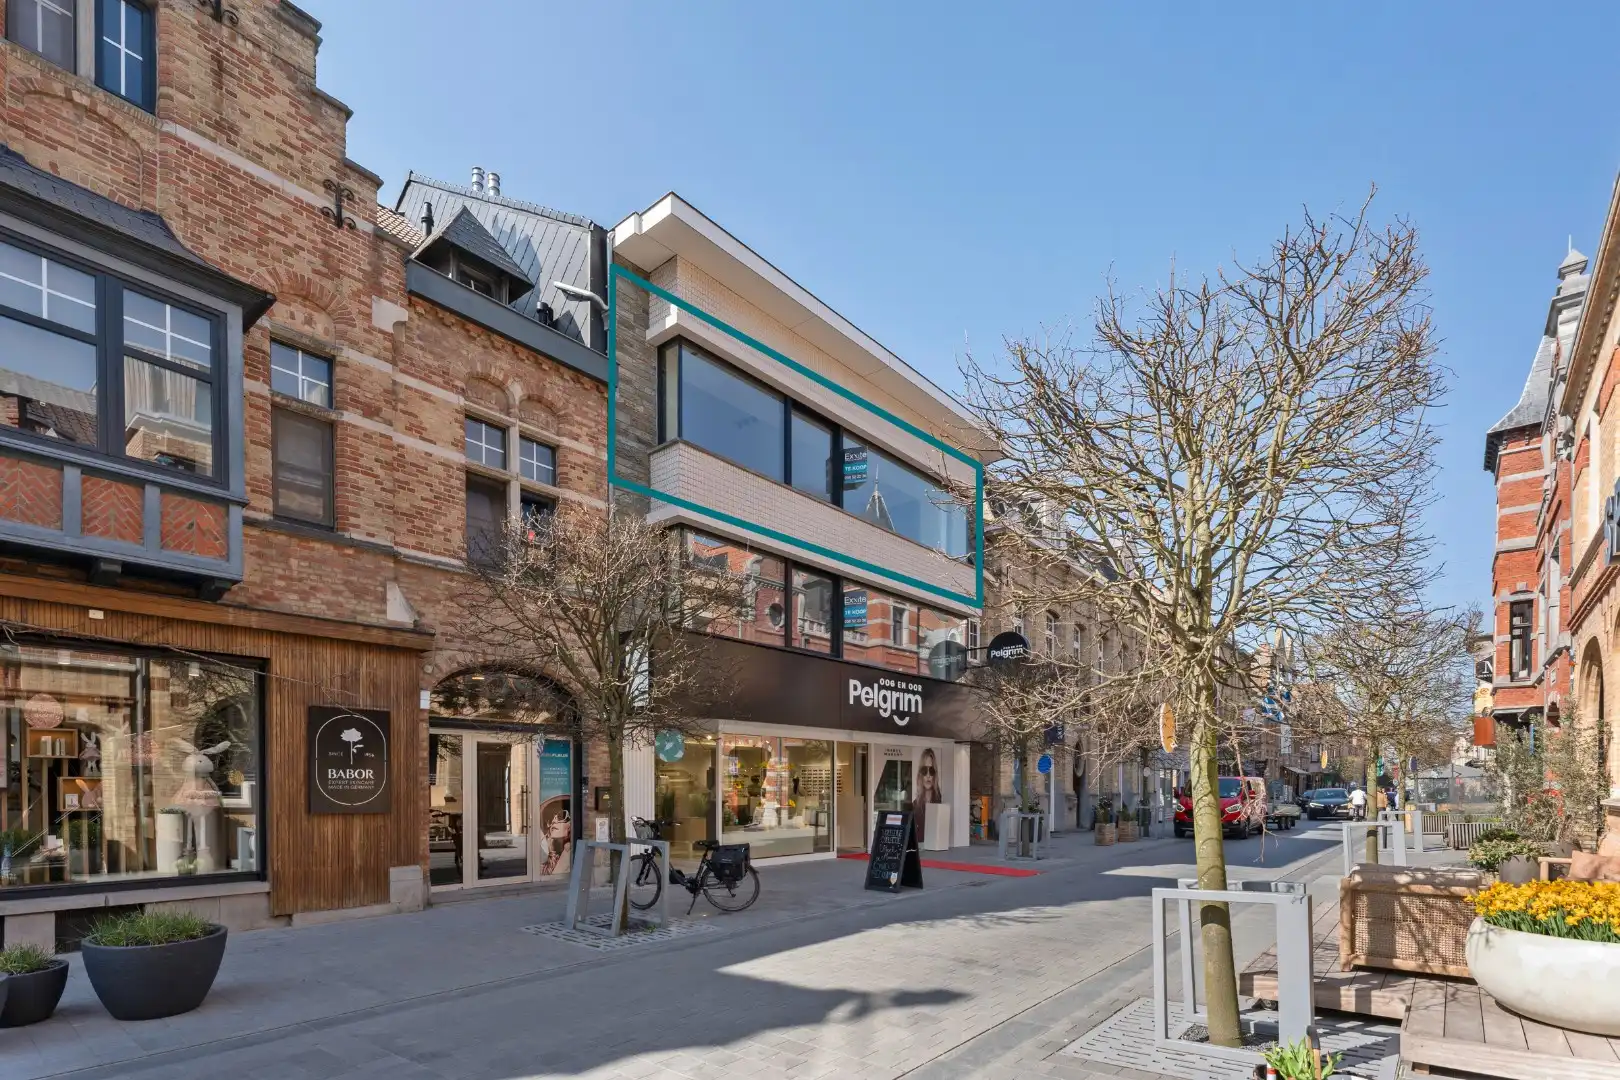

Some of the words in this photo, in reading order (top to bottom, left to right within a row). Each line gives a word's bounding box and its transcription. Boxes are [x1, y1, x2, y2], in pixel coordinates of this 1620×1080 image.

[990, 647, 1024, 659] Pelgrim
[880, 678, 895, 687] OOG
[897, 681, 907, 690] EN
[908, 683, 922, 692] OOR
[849, 678, 923, 718] Pelgrim
[328, 769, 374, 779] BABOR
